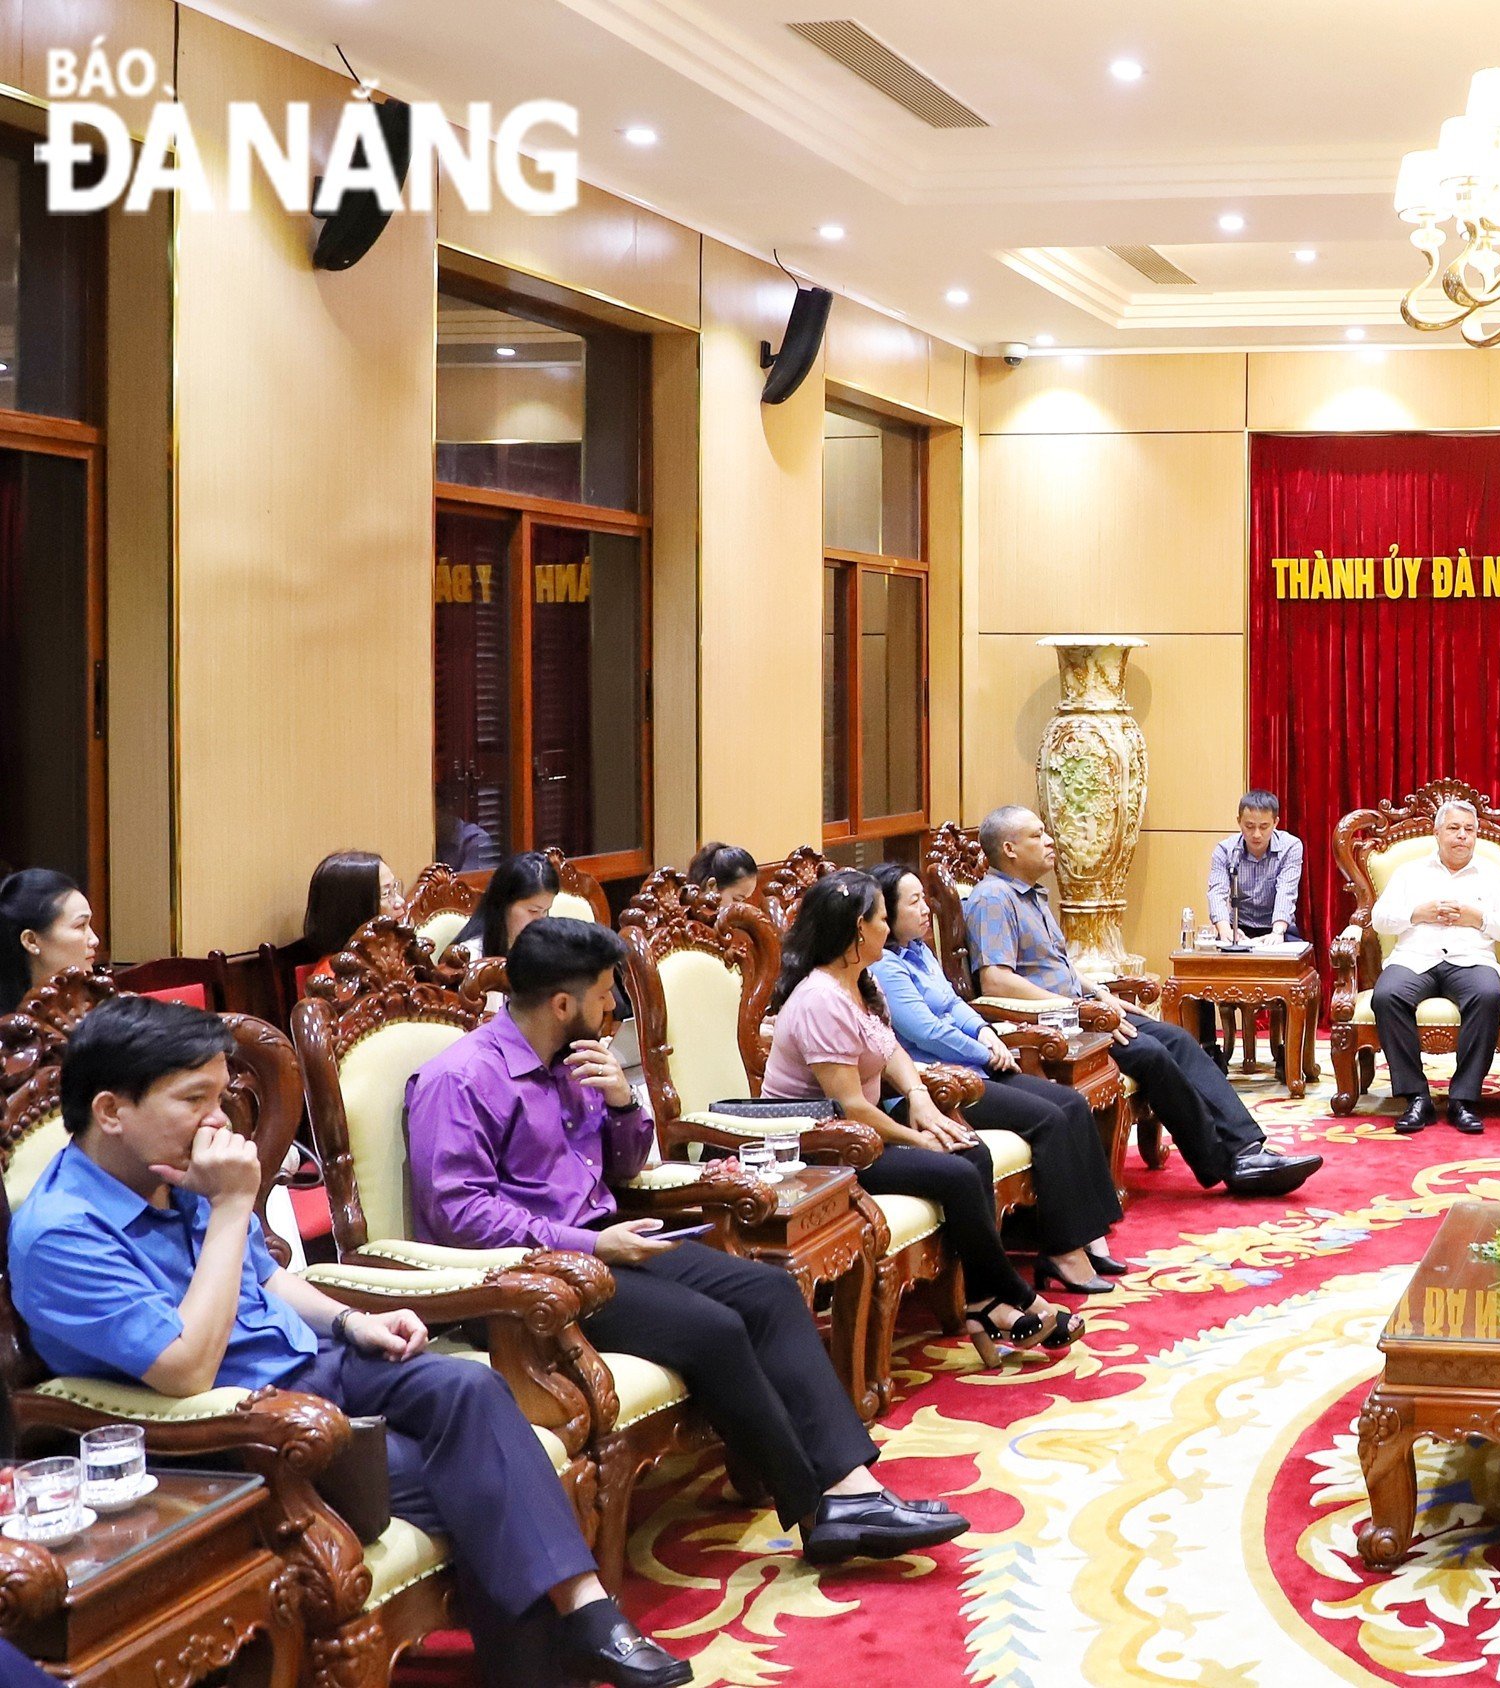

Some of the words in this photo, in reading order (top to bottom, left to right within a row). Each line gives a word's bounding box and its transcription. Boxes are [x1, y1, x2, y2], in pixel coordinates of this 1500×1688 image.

[1272, 549, 1375, 599] THÀNH
[1384, 543, 1423, 599] ỦY
[1432, 547, 1476, 598] ĐÀ
